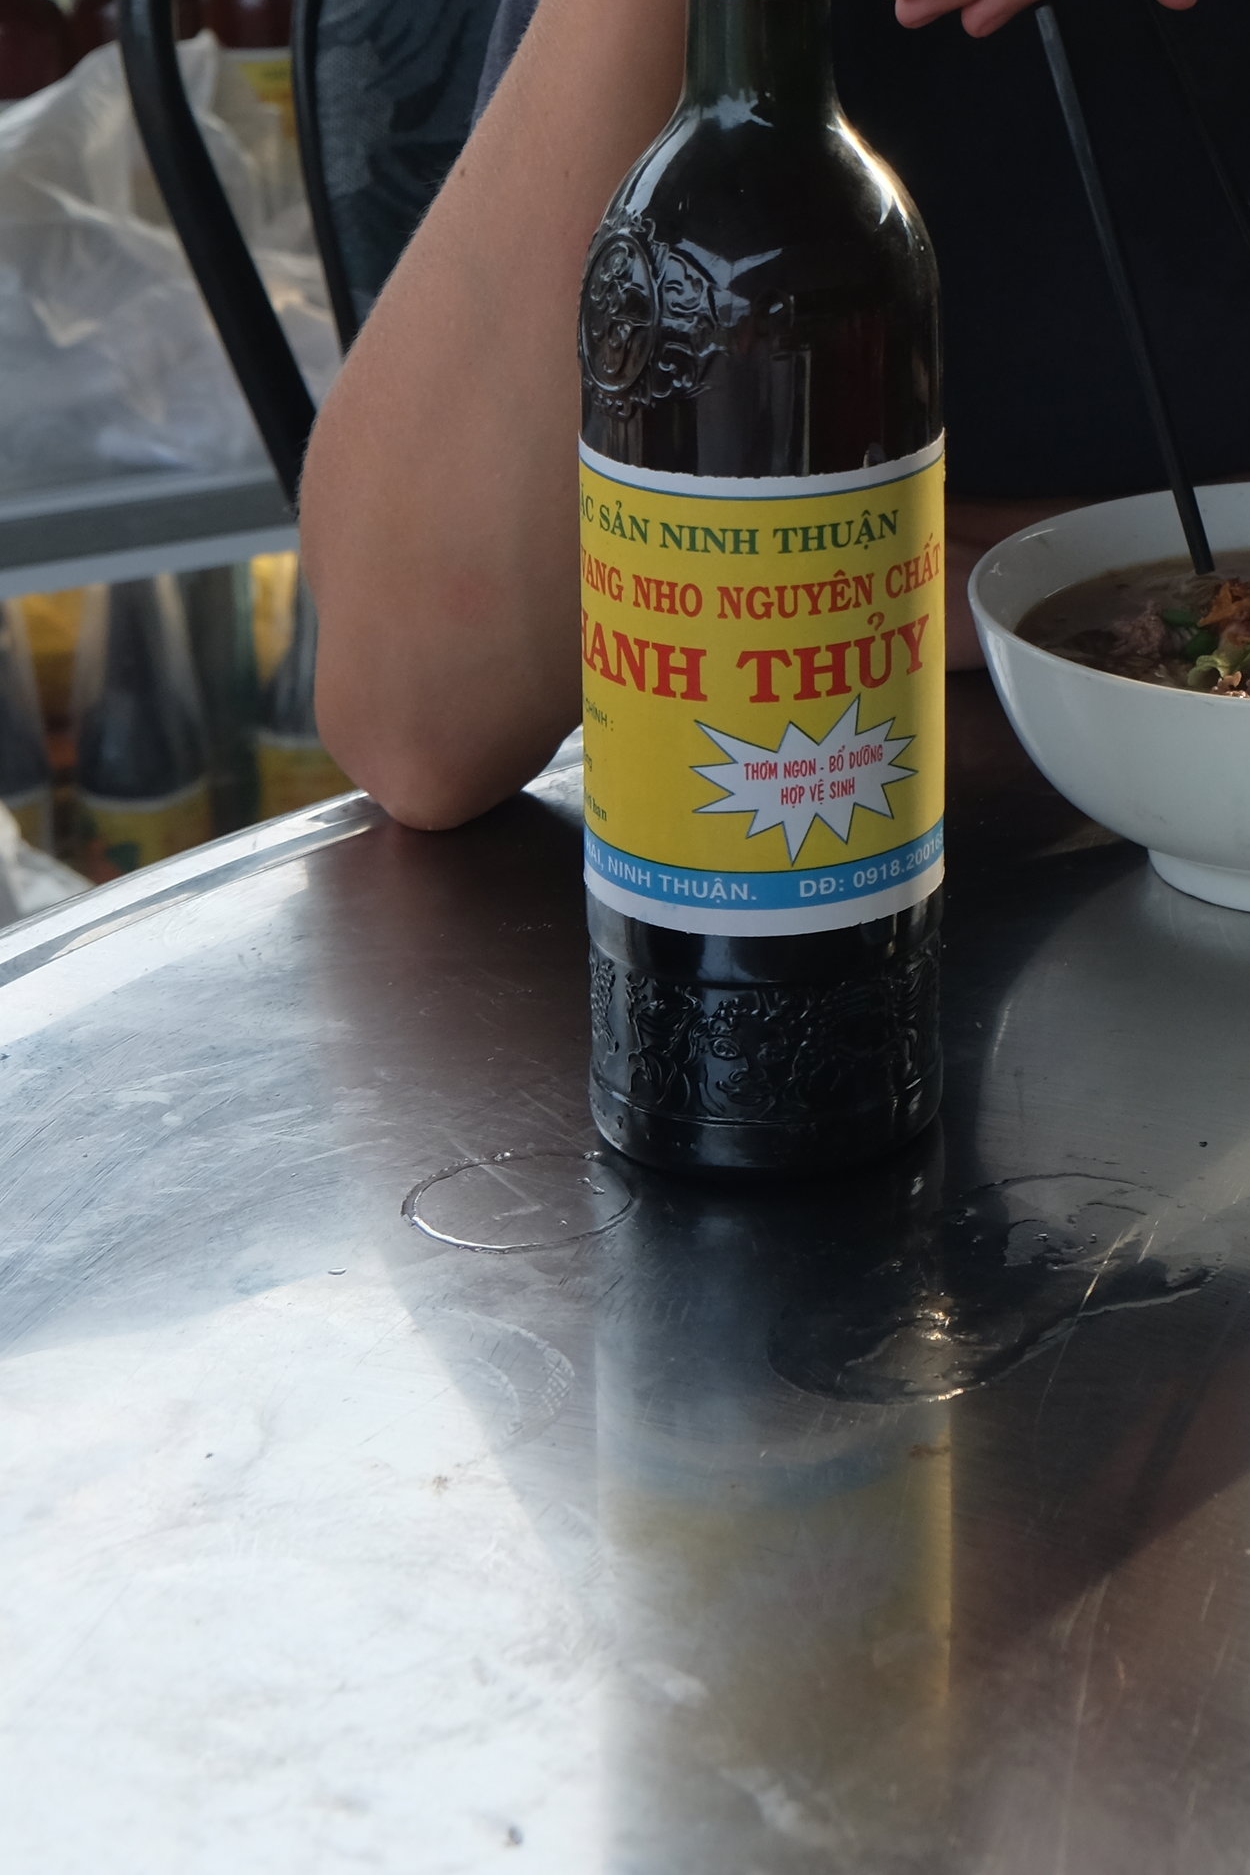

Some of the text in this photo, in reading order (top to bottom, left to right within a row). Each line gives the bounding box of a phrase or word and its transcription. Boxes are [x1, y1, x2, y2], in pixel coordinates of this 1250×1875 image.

[599, 500, 650, 545] SẢN
[659, 522, 759, 555] NINH
[773, 509, 898, 550] THUẬN
[632, 574, 703, 618] NHO
[716, 569, 874, 621] NGUYÊN
[885, 532, 941, 599] CHẤT
[736, 611, 930, 703] THỦY
[744, 760, 778, 781] THƠM
[783, 758, 816, 779] NGON
[829, 745, 846, 774] BỔ
[849, 743, 884, 770] DƯỠNG
[781, 777, 856, 809] HỢP VỆ SINH
[608, 856, 651, 889] NINH
[658, 874, 757, 903] THUẬN.
[800, 877, 844, 898] DĐ:
